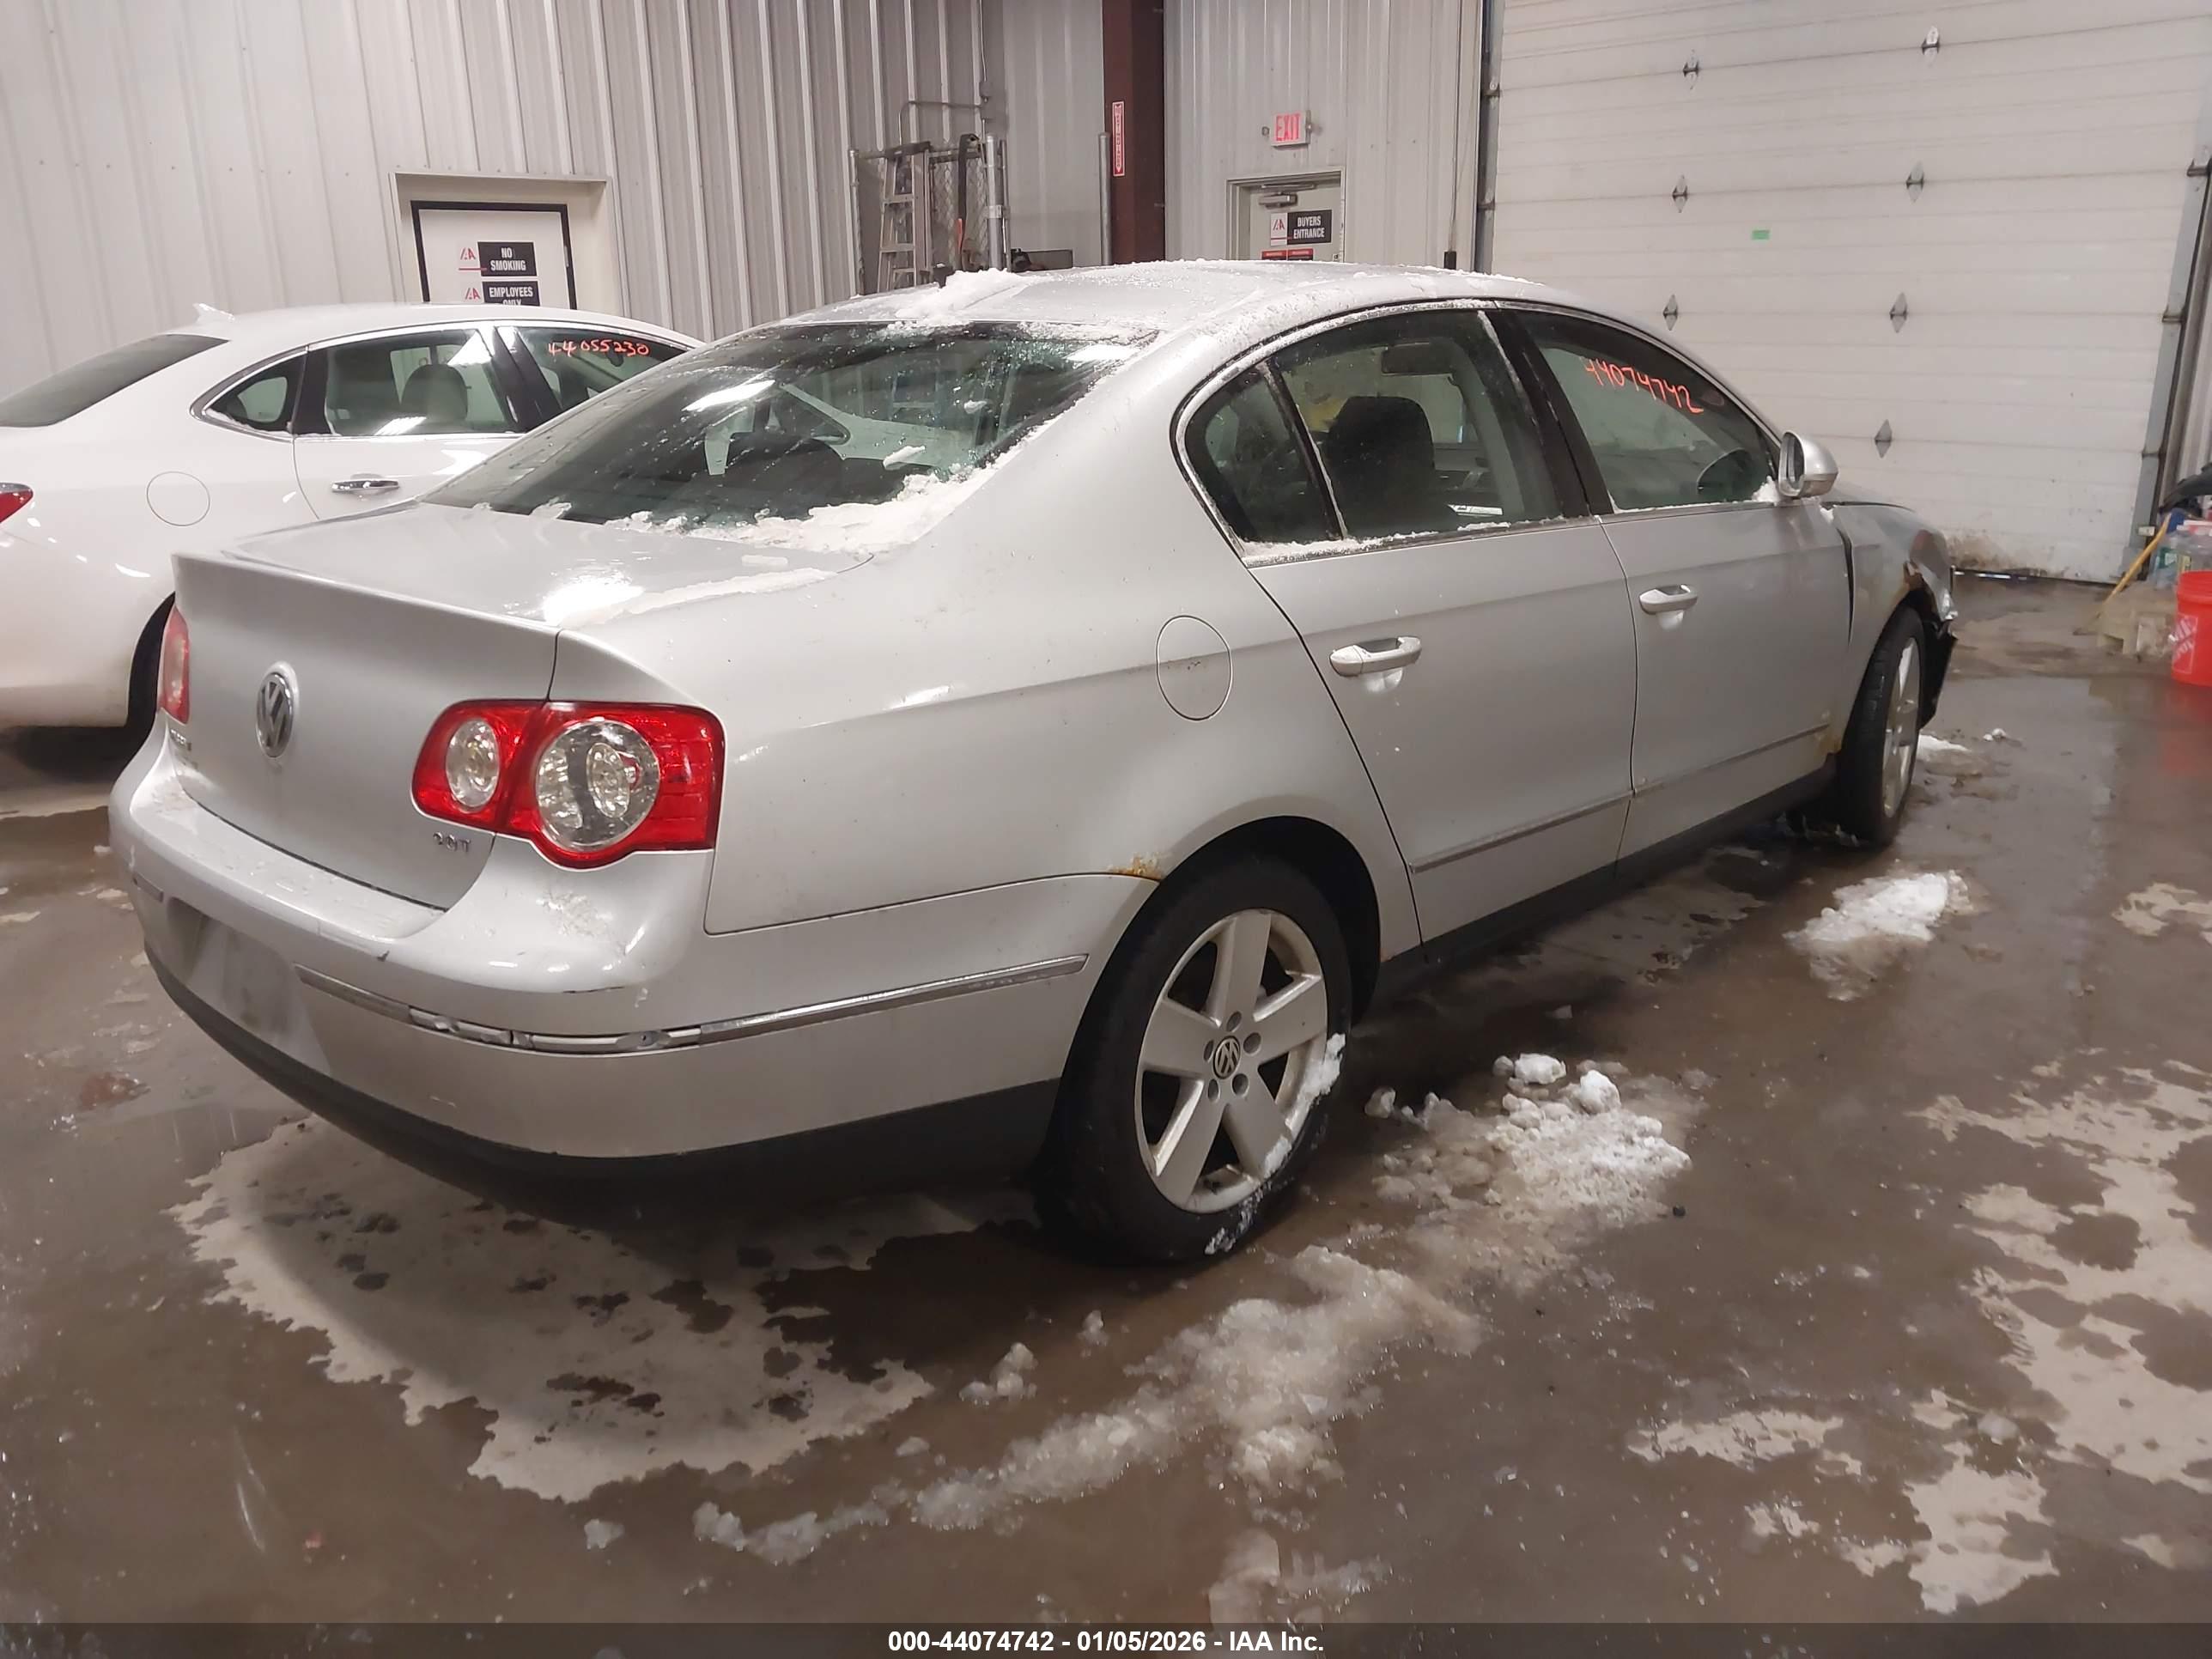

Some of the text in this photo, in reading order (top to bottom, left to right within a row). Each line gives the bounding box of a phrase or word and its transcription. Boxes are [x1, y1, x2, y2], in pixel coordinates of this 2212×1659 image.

[1275, 113, 1301, 142] EXIT
[1297, 216, 1322, 227] BUYERS
[1293, 228, 1325, 239] ENTRANCE
[501, 247, 513, 258] NO
[490, 260, 526, 271] SMOKING
[489, 287, 533, 298] EMPLOYEES
